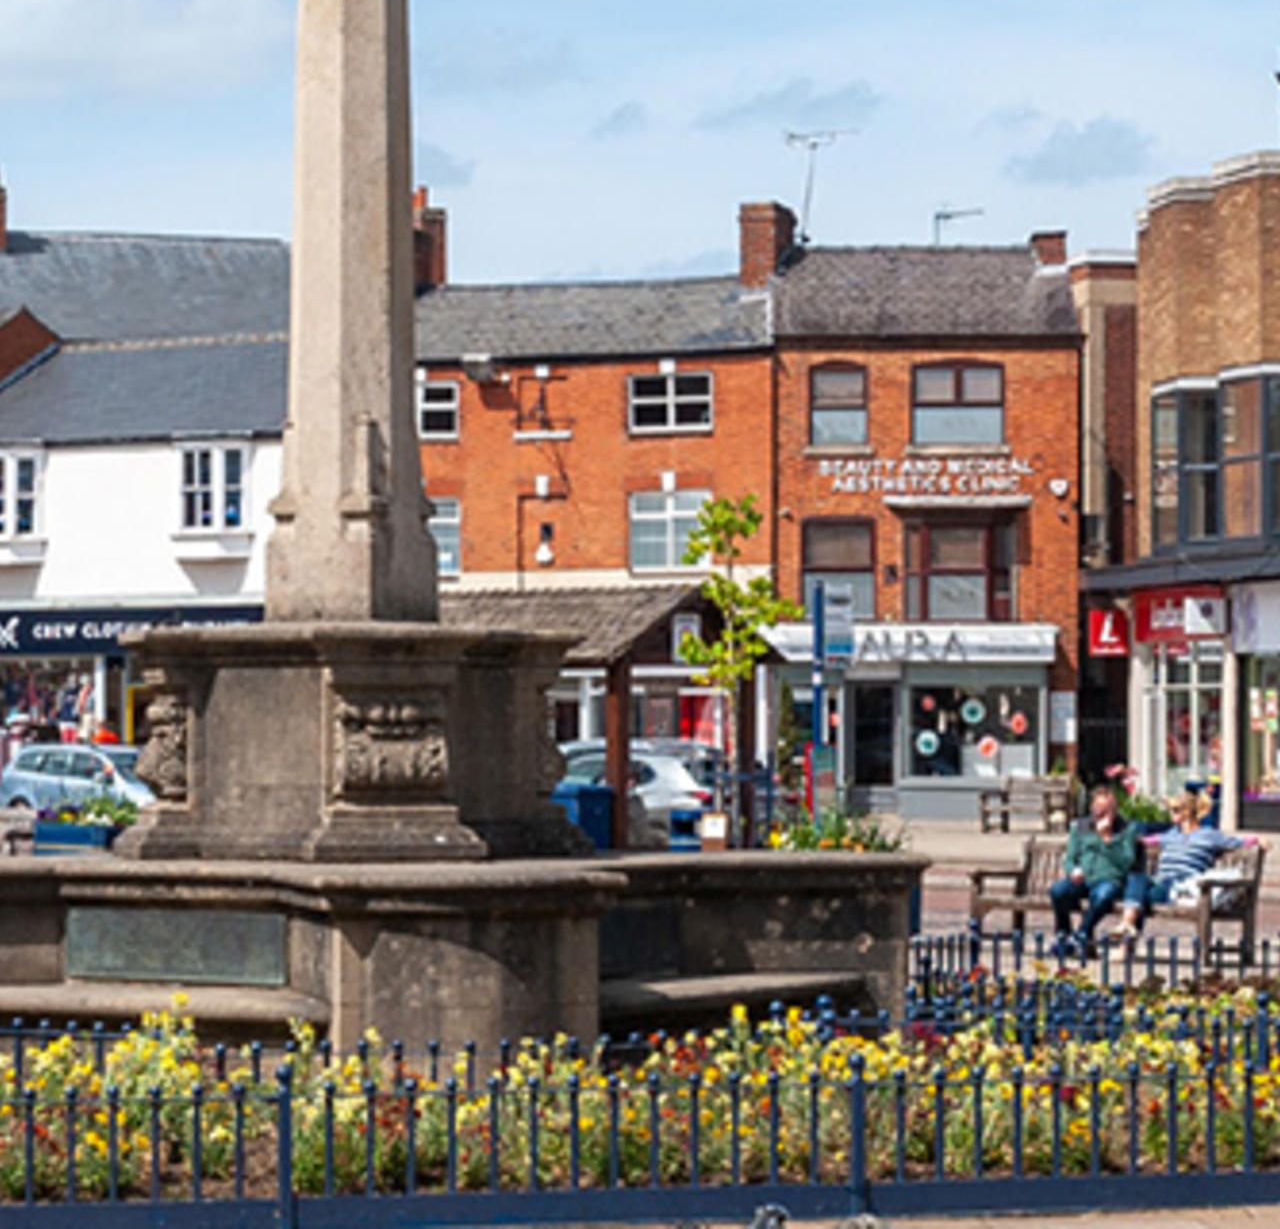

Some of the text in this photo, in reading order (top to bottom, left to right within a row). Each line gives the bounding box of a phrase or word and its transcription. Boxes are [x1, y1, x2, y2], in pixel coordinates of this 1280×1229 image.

[820, 458, 1035, 476] BEAUTY AND MEDICAL
[831, 475, 1020, 492] AESTHETICS CLINIC
[32, 622, 76, 639] CREW
[857, 630, 968, 662] AURA
